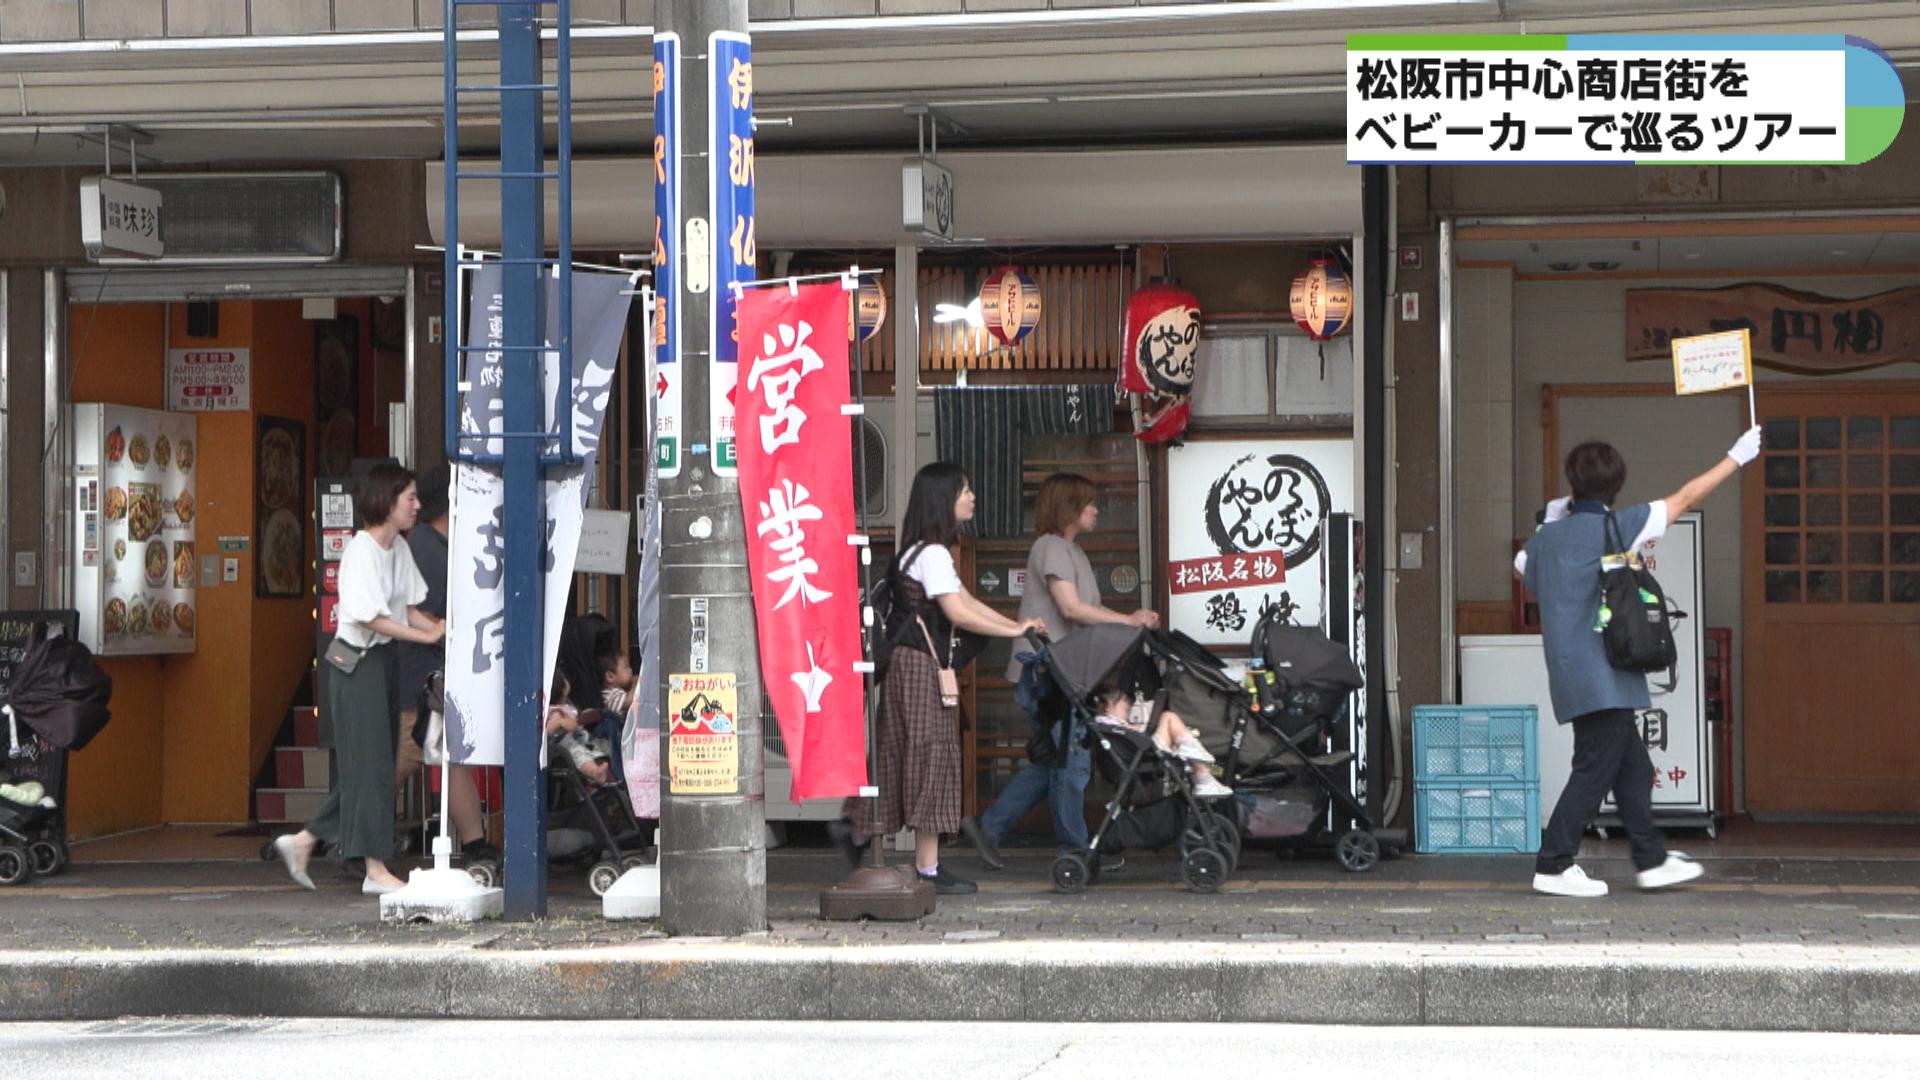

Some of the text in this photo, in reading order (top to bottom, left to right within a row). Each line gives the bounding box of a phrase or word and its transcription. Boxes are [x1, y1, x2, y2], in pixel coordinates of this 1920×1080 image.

[124, 202, 155, 237] 味珍
[1175, 555, 1278, 588] 松阪名物
[683, 678, 731, 692] おねがい
